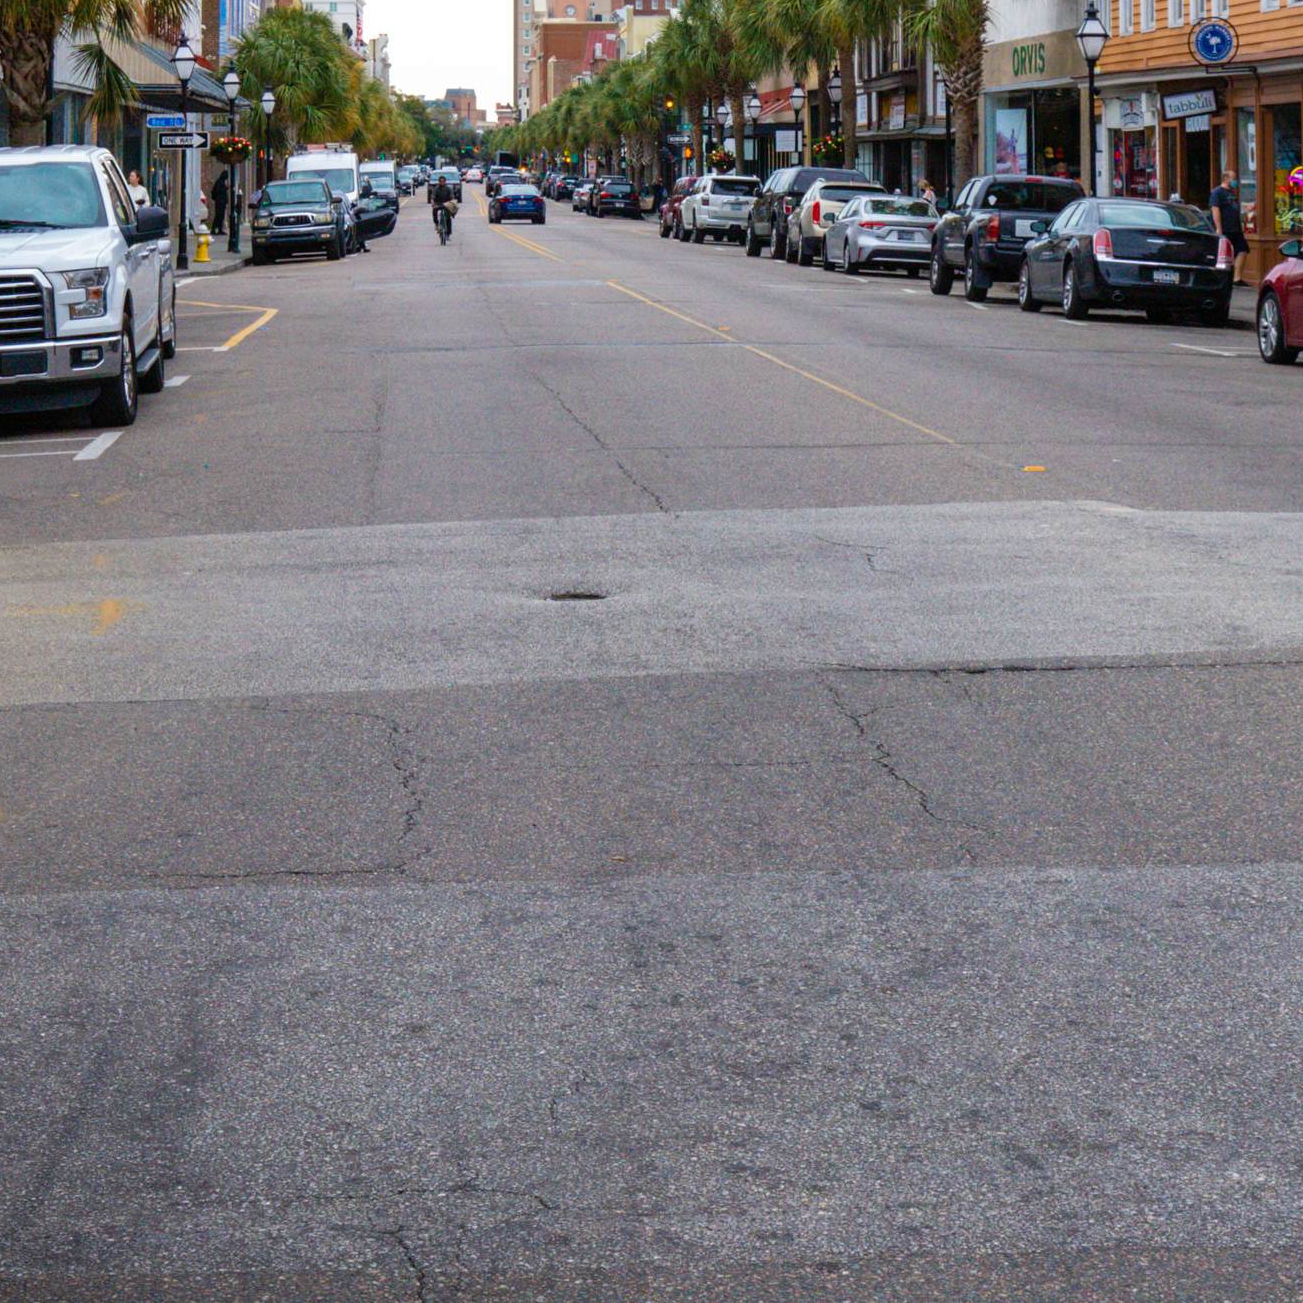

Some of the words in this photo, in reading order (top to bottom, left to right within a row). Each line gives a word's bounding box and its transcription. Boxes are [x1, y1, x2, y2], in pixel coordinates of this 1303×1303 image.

[1012, 42, 1046, 76] ORVIS
[163, 137, 178, 145] ONE
[179, 137, 193, 145] WAY
